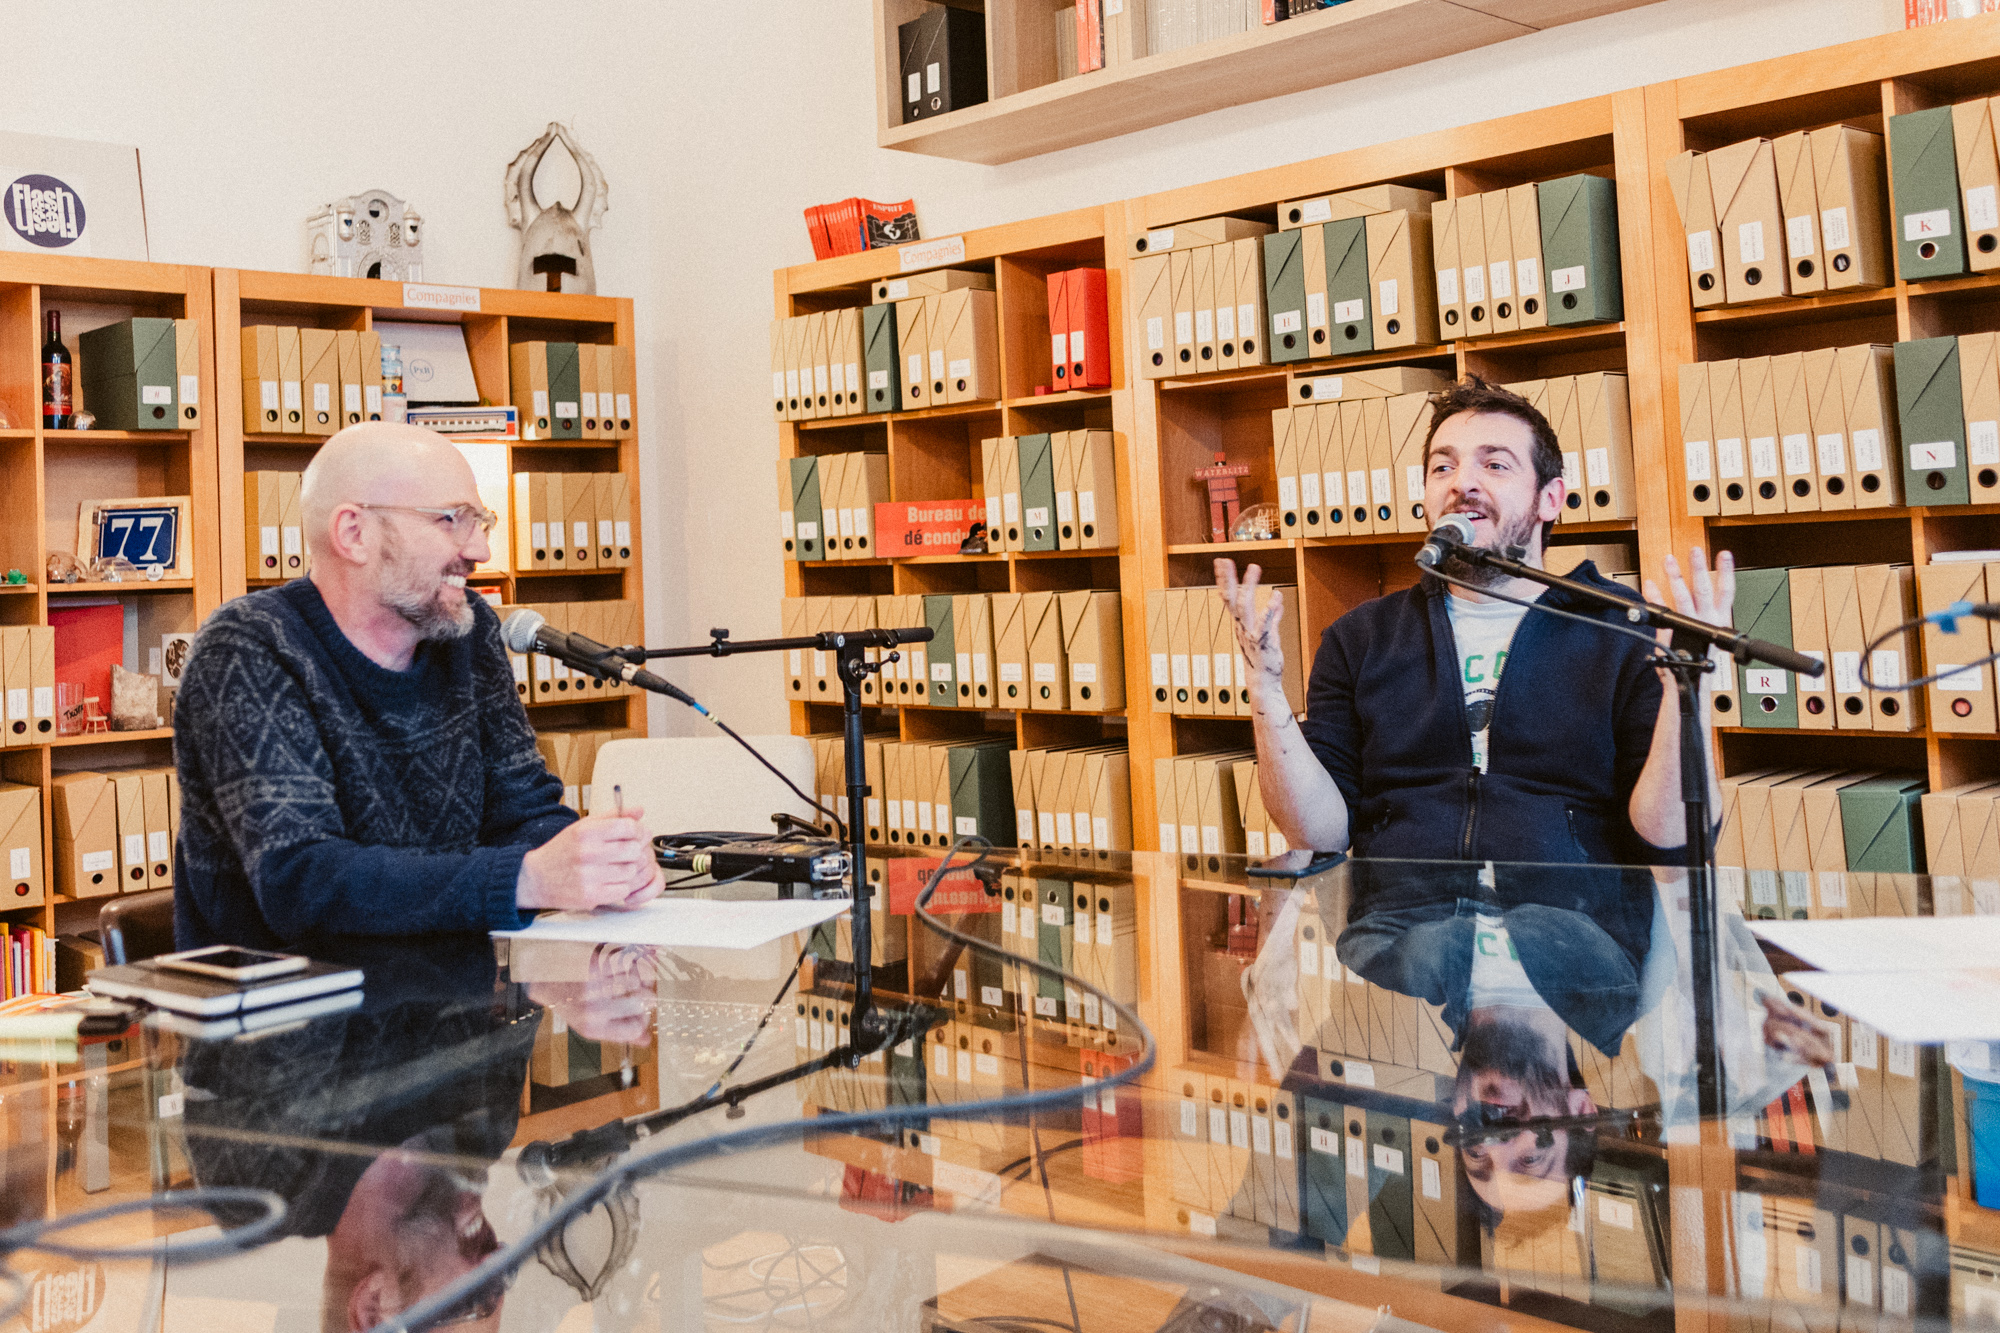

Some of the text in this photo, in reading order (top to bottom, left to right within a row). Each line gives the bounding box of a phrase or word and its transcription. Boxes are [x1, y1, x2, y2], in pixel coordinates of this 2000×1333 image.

[872, 203, 904, 213] ESPRIT
[1921, 220, 1932, 232] K
[903, 242, 962, 265] Compagnies
[1564, 274, 1570, 284] J
[407, 288, 477, 306] Compagnies
[907, 506, 963, 523] Bureau
[111, 516, 165, 560] 77
[1760, 676, 1770, 687] R
